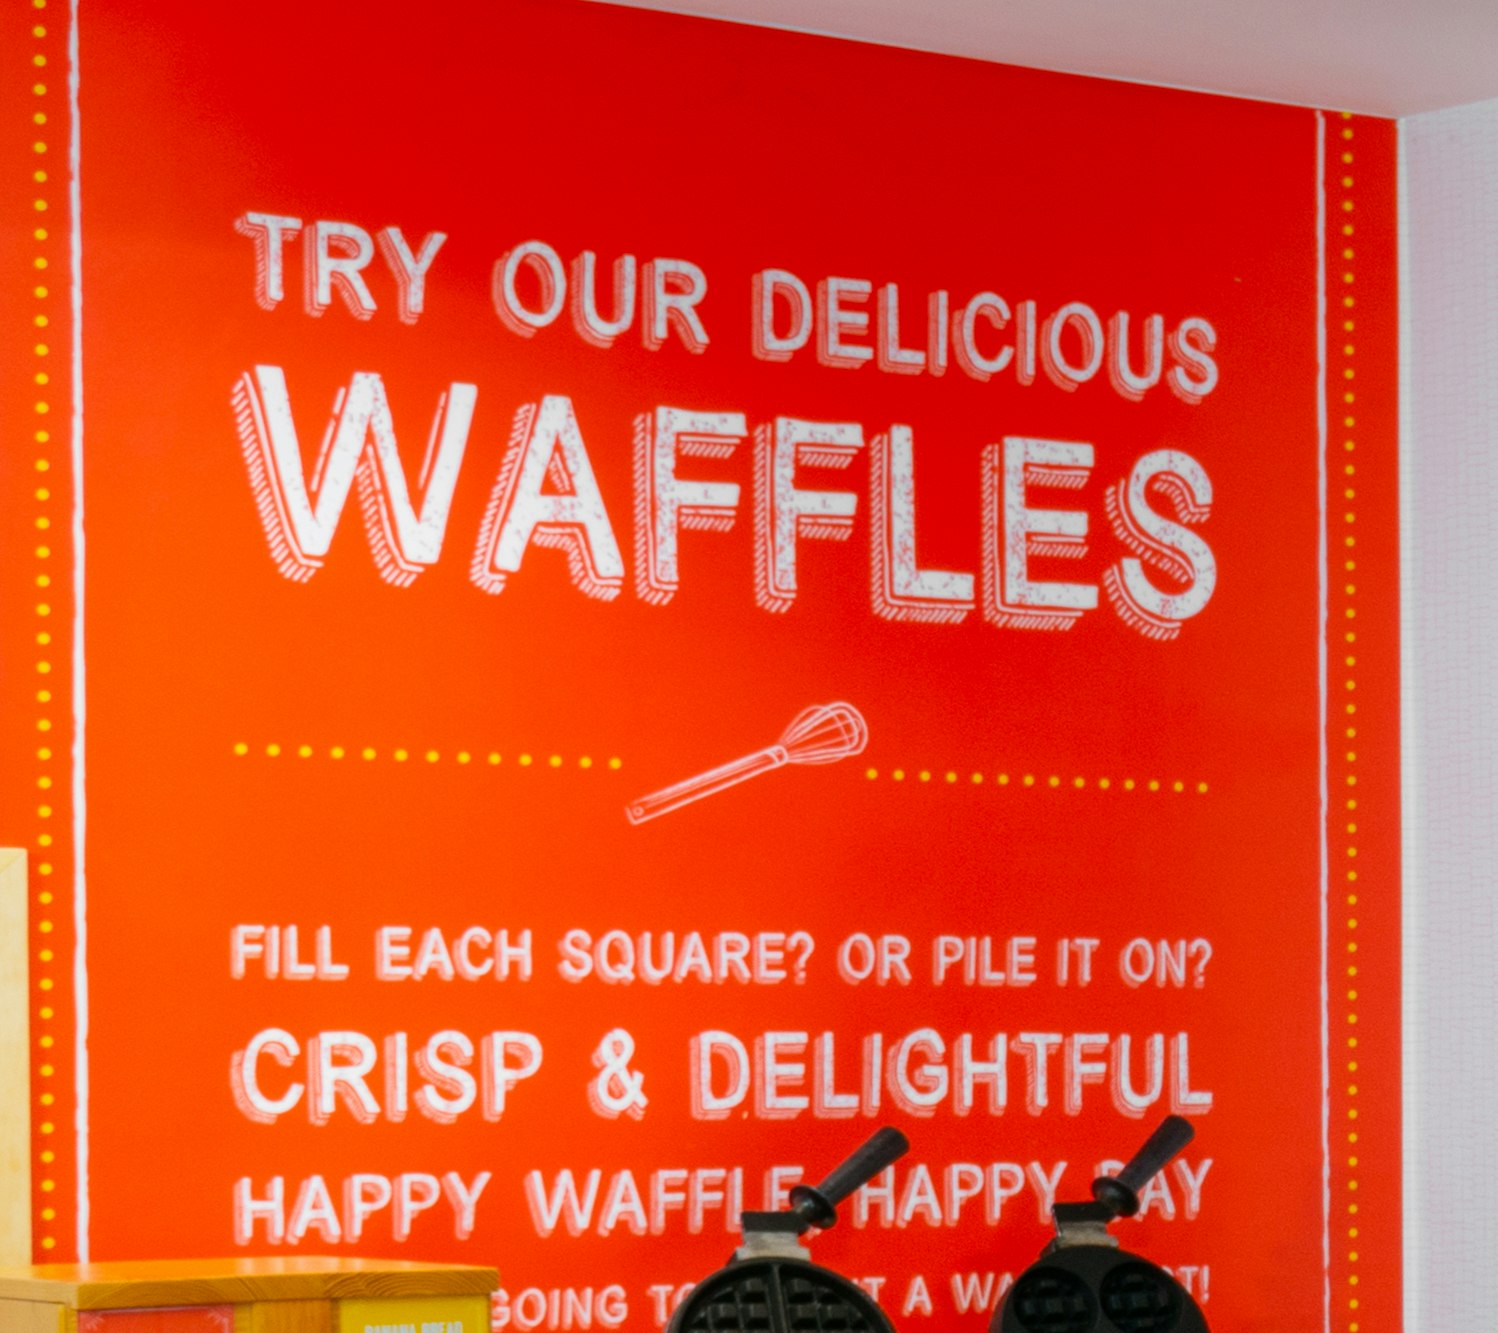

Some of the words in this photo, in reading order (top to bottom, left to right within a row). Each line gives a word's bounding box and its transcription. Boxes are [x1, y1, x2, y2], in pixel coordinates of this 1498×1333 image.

[235, 212, 447, 323] TRY
[493, 240, 709, 353] OUR
[752, 269, 1220, 404] DELICIOUS
[231, 364, 1218, 640] WAFFLES
[231, 924, 349, 981] FILL
[375, 925, 533, 982] EACH
[558, 929, 815, 985] SQUARE?
[838, 932, 912, 985] OR
[933, 935, 1038, 987] PILE
[1057, 937, 1100, 987] IT
[1120, 937, 1214, 989] ON?
[231, 1027, 544, 1127] CRISP
[587, 1027, 649, 1121] &
[690, 1027, 1214, 1120] DELIGHTFUL
[233, 1170, 493, 1246] HAPPY
[853, 1160, 1068, 1228] HAPPY
[491, 1284, 629, 1333] GOING
[902, 1274, 933, 1318] A
